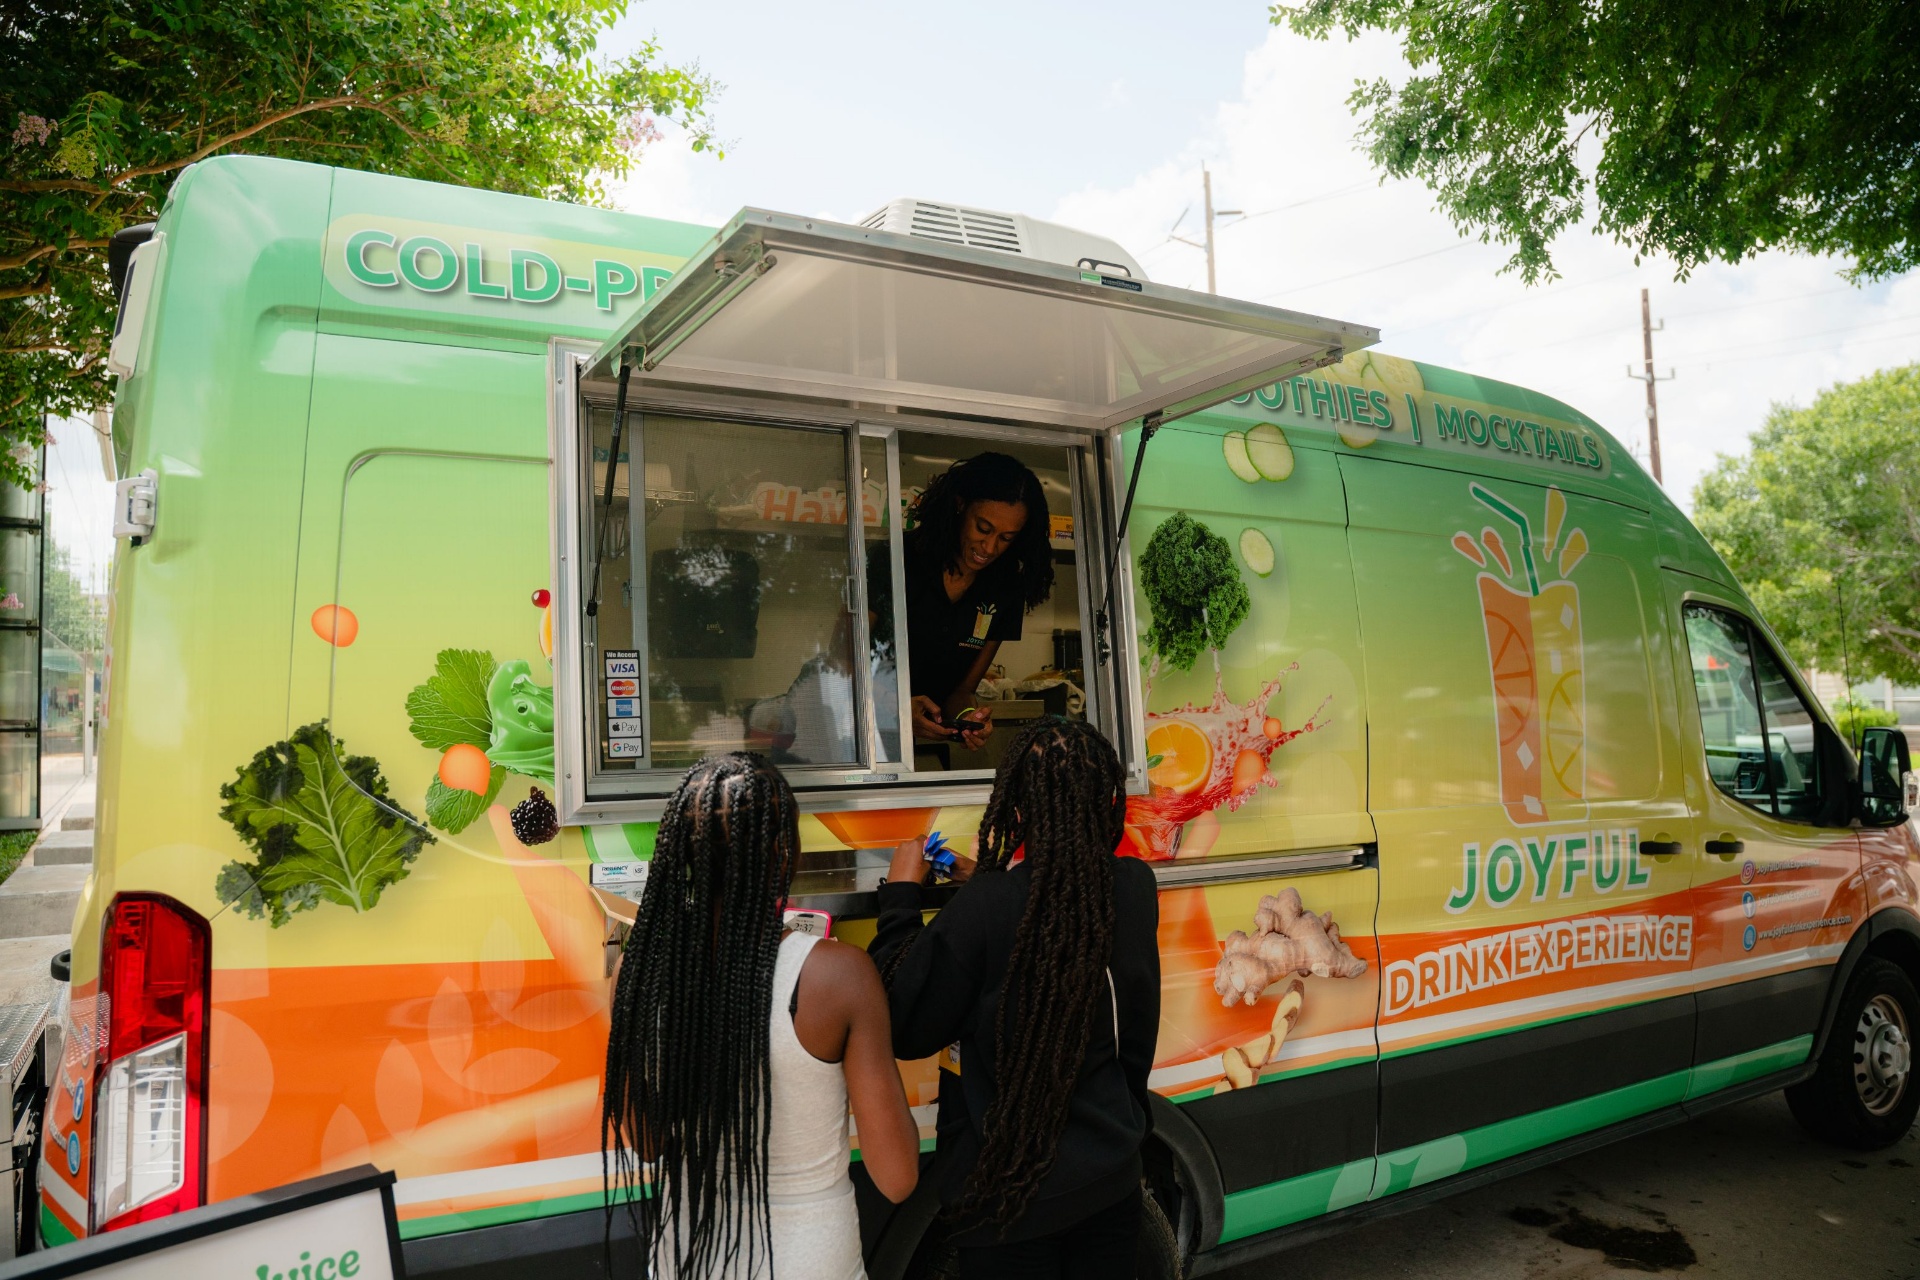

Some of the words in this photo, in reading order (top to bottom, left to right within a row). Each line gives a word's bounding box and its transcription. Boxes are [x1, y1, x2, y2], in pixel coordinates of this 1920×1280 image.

[1231, 376, 1392, 428] OTHIES
[1433, 401, 1601, 469] MOCKTAILS
[609, 663, 636, 673] VISA
[621, 722, 638, 734] Pay
[623, 743, 639, 754] Pay
[1445, 829, 1651, 912] JOYFUL
[794, 922, 814, 932] 2:37
[1386, 933, 1509, 1016] DRINK
[1510, 915, 1692, 980] EXPERIENCE
[256, 1249, 361, 1280] ice
